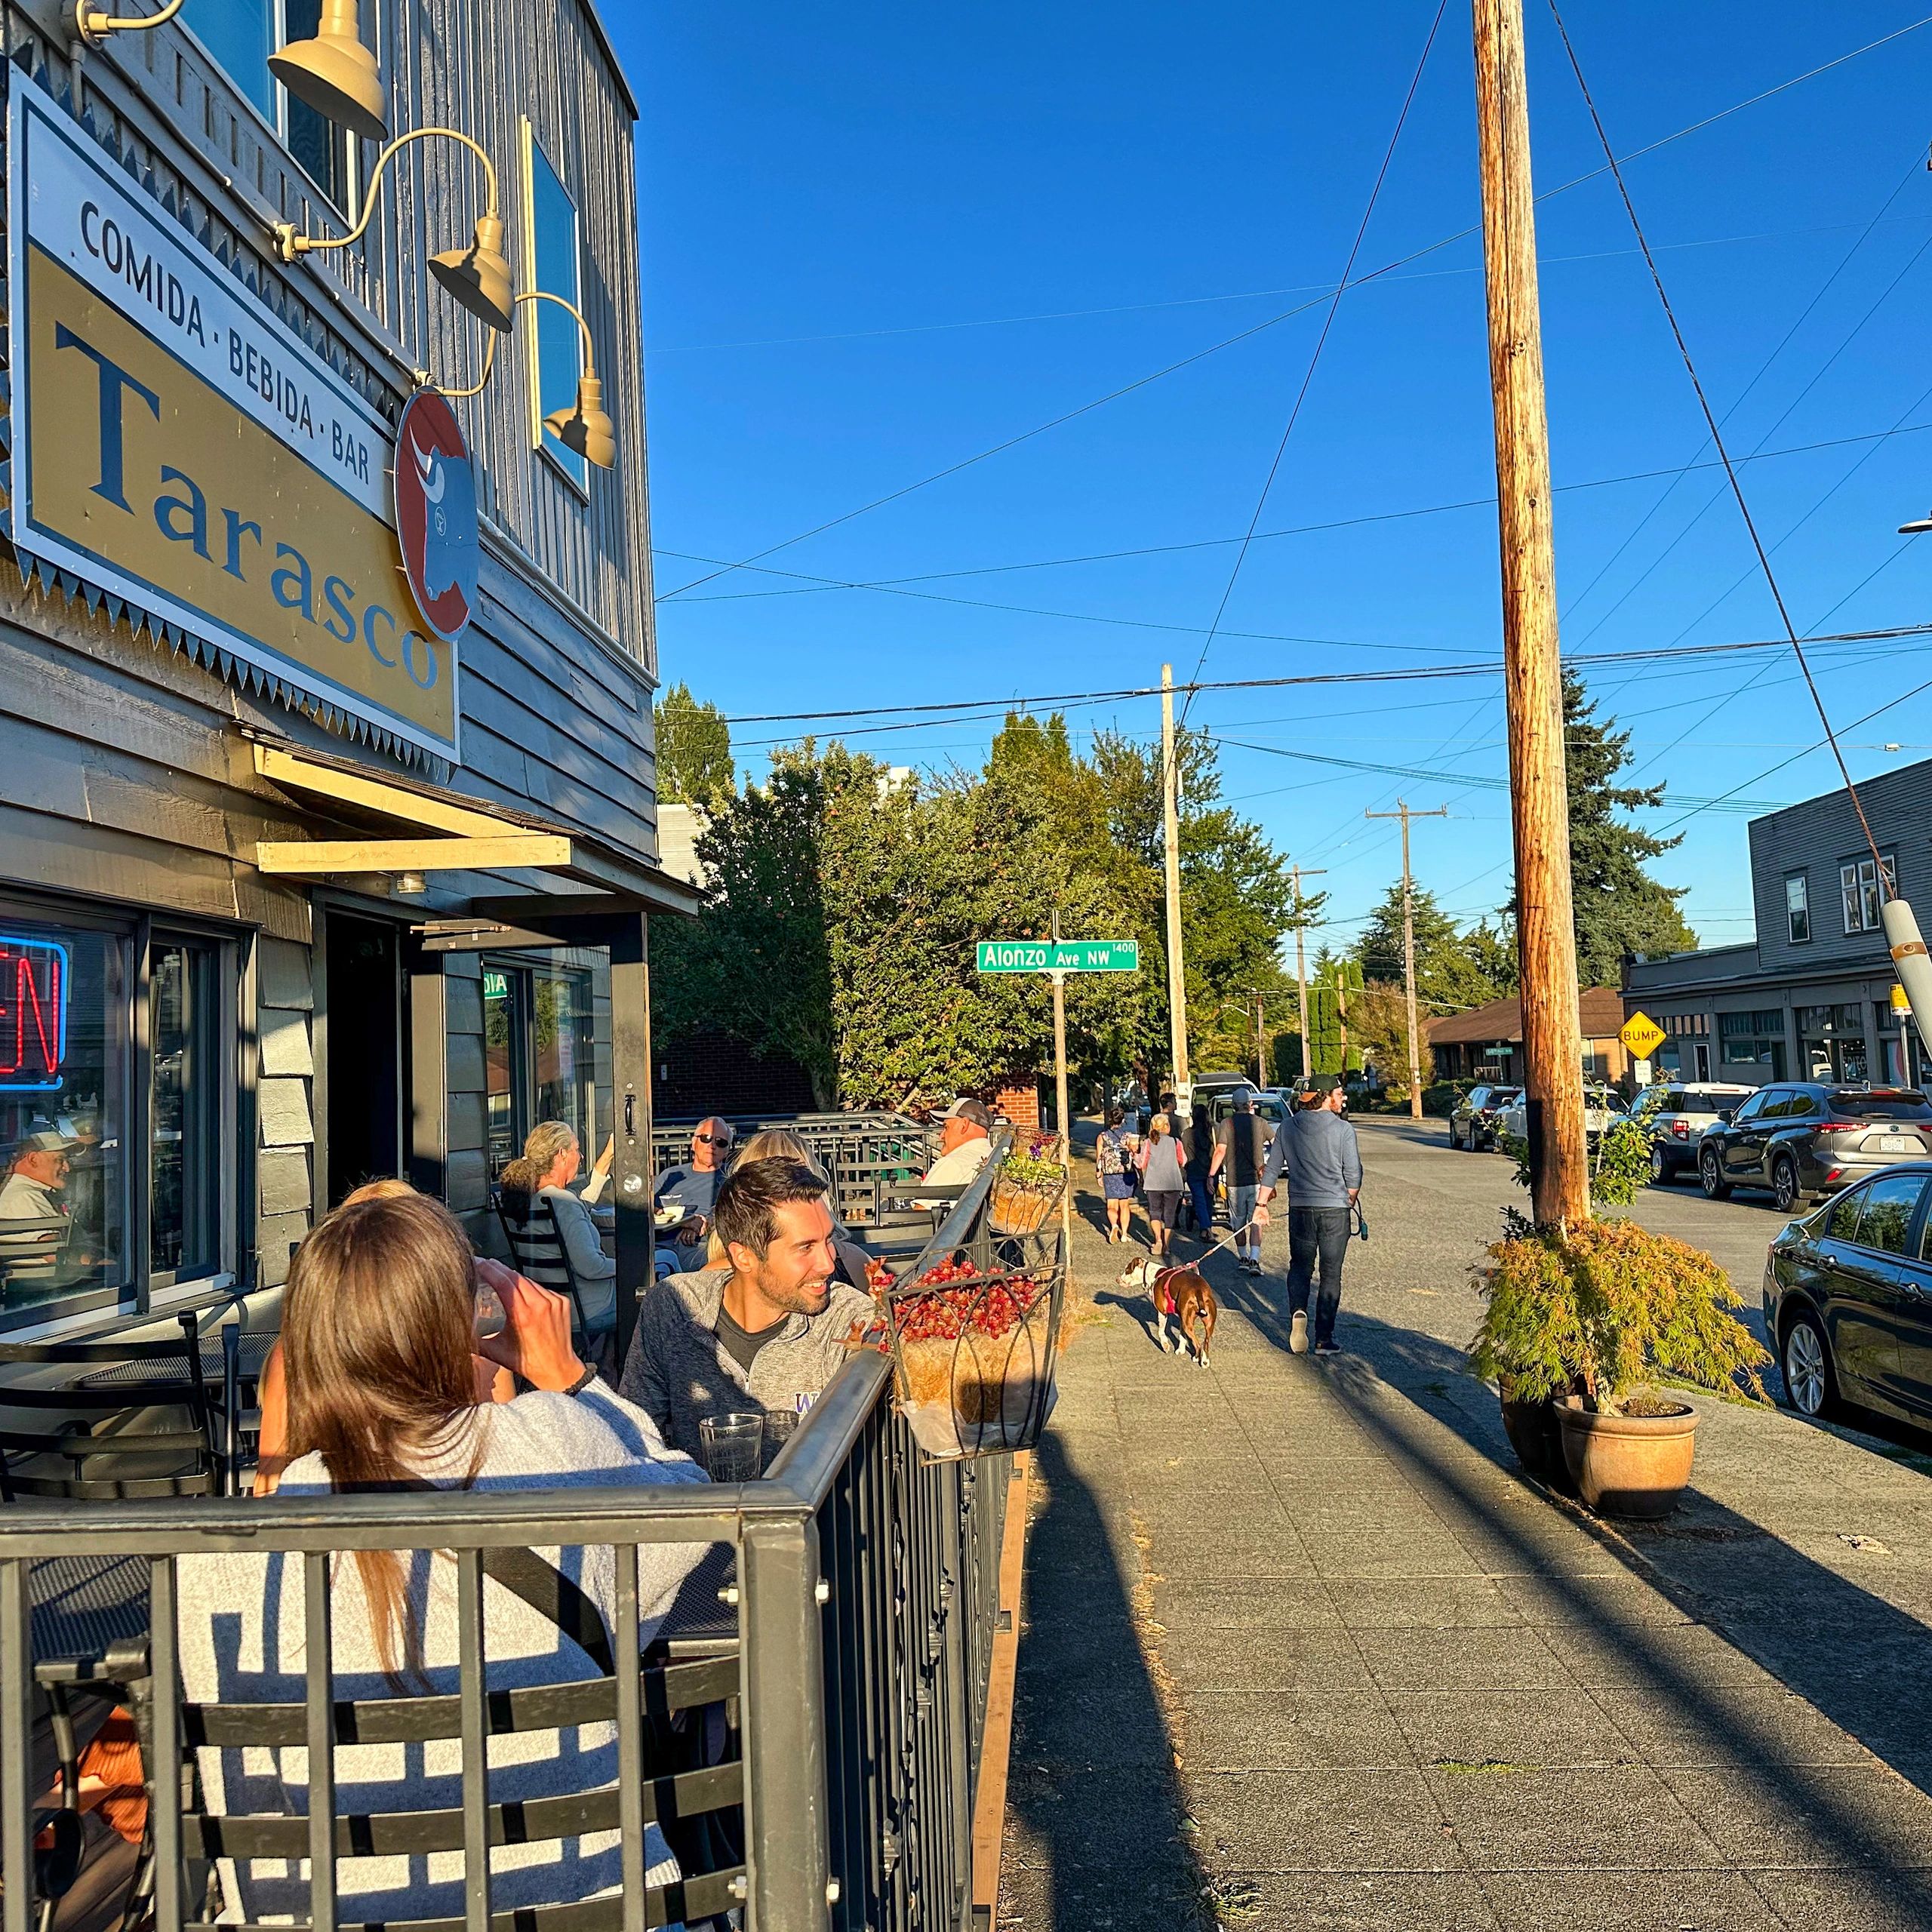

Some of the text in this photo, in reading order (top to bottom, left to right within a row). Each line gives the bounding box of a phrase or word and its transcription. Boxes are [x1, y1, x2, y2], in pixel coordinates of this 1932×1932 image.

[81, 200, 369, 485] COMIDA BEBIDA BAR
[55, 320, 438, 690] Tarasco
[984, 943, 1134, 967] Alonzo Ave NW 1400
[1623, 1031, 1659, 1041] BUMP
